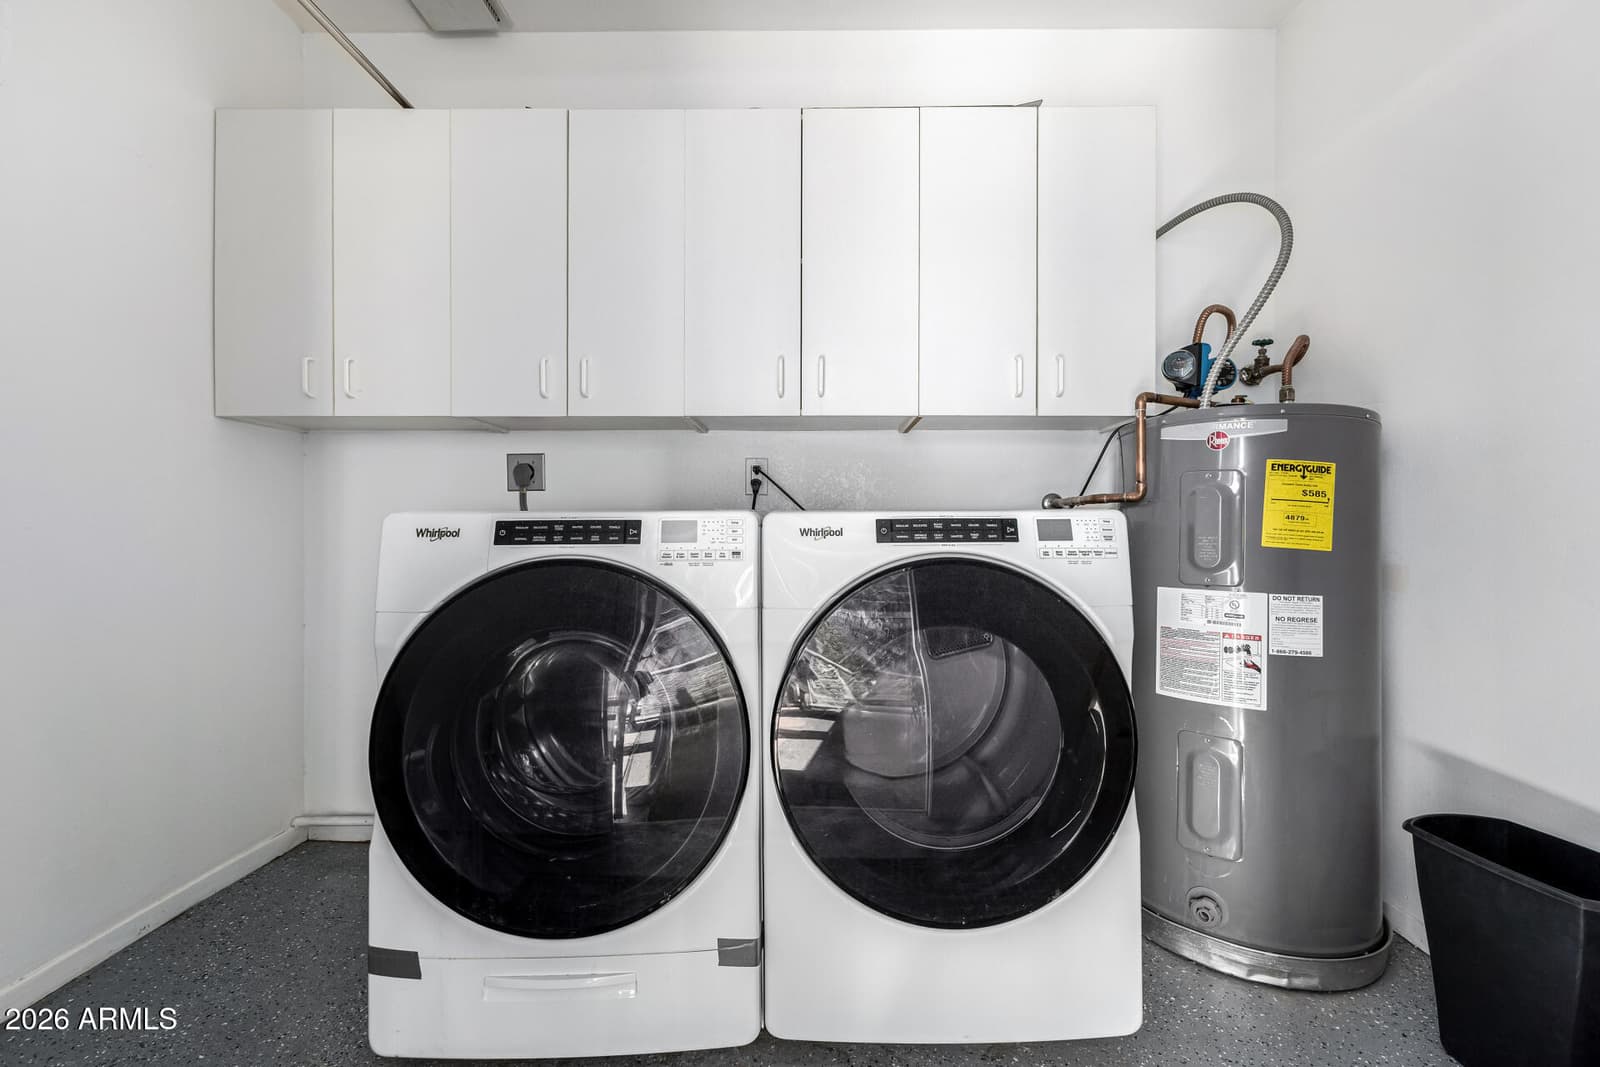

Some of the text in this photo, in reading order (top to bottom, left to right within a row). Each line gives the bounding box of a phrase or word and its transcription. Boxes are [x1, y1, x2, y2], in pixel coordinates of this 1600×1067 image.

[1271, 463, 1332, 475] ENERGYGUIDE
[1301, 489, 1327, 498] $585
[416, 527, 461, 541] Whirlpool
[799, 527, 843, 540] Whirlpool
